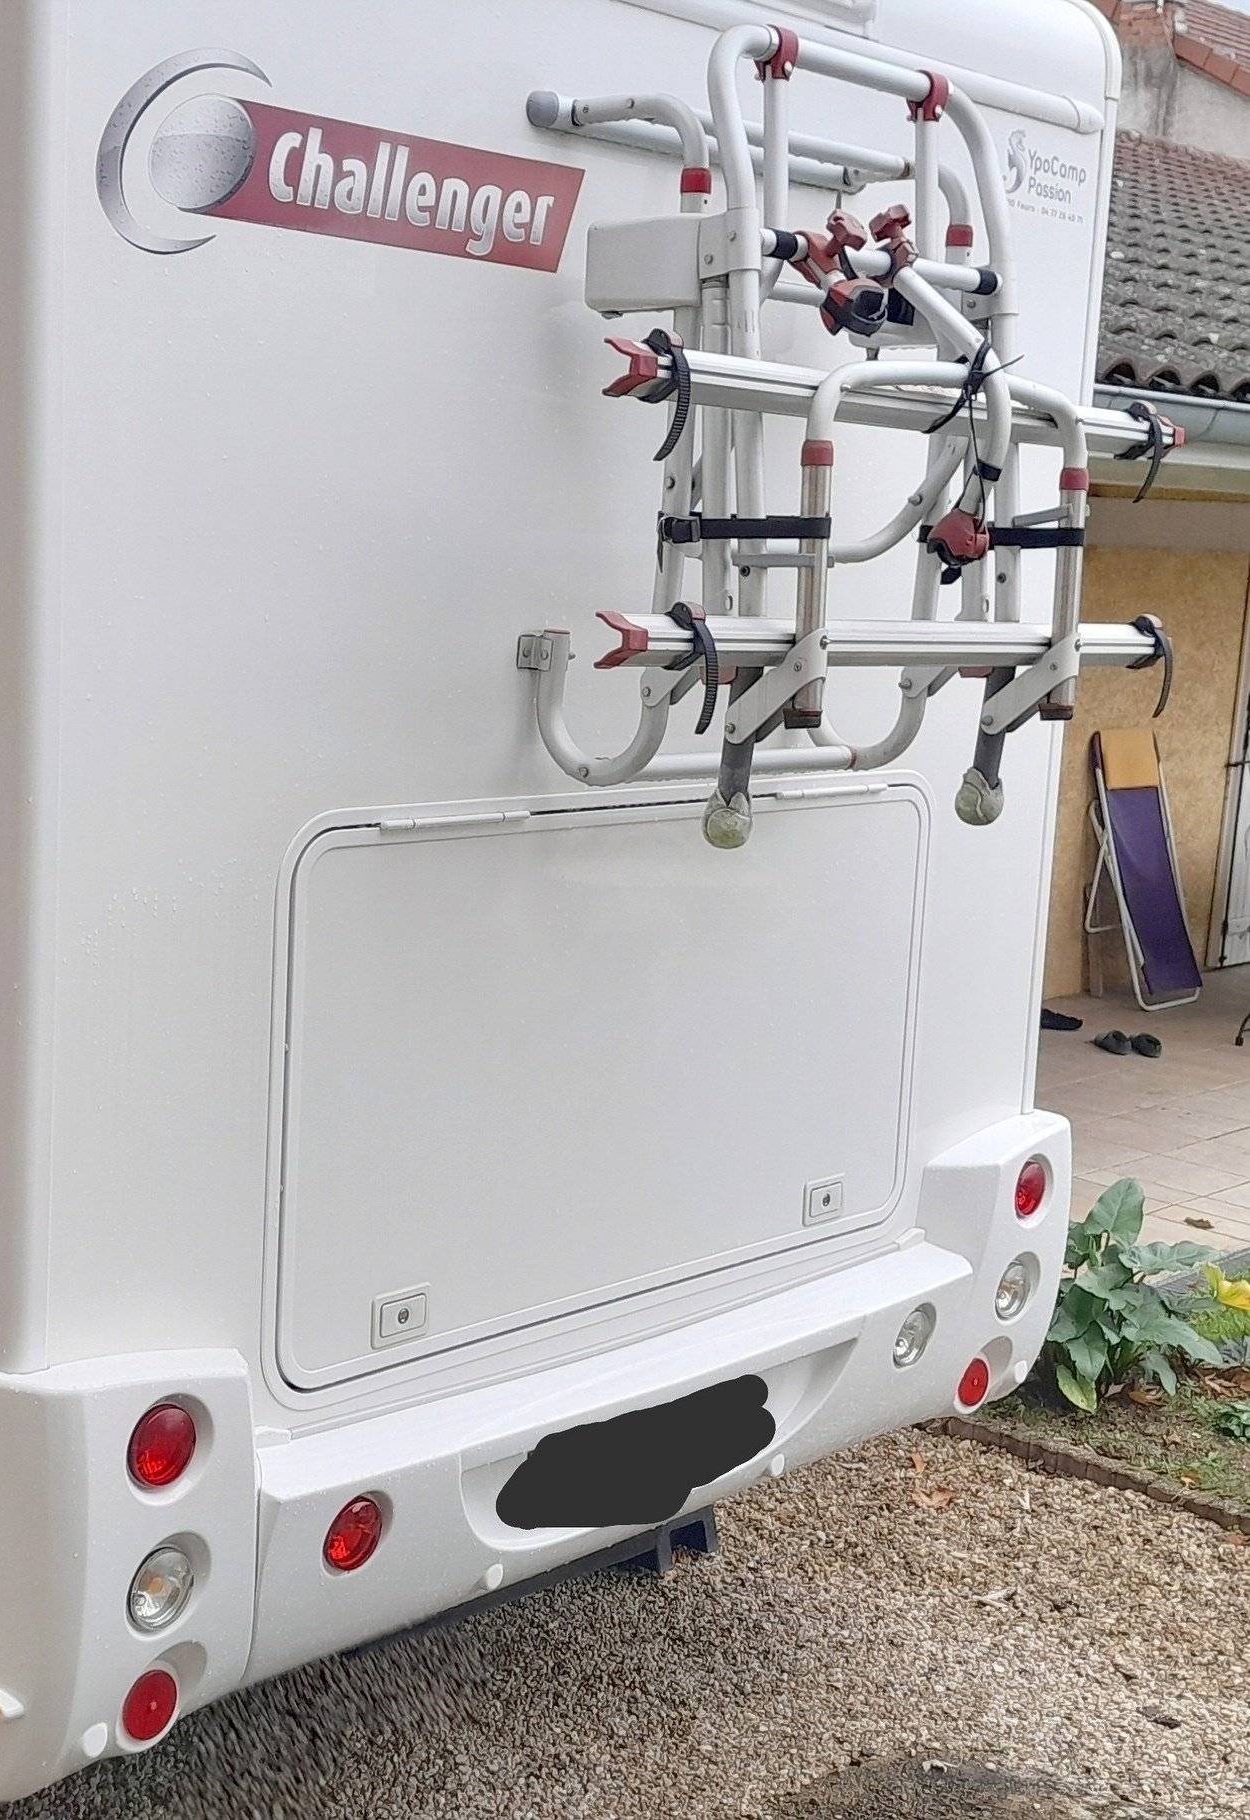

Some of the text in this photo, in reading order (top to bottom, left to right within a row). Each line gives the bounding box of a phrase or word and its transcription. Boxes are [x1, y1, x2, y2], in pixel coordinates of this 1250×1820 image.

[1028, 149, 1087, 186] YpoCamp
[268, 126, 555, 256] Challenger
[1028, 176, 1072, 204] Passion
